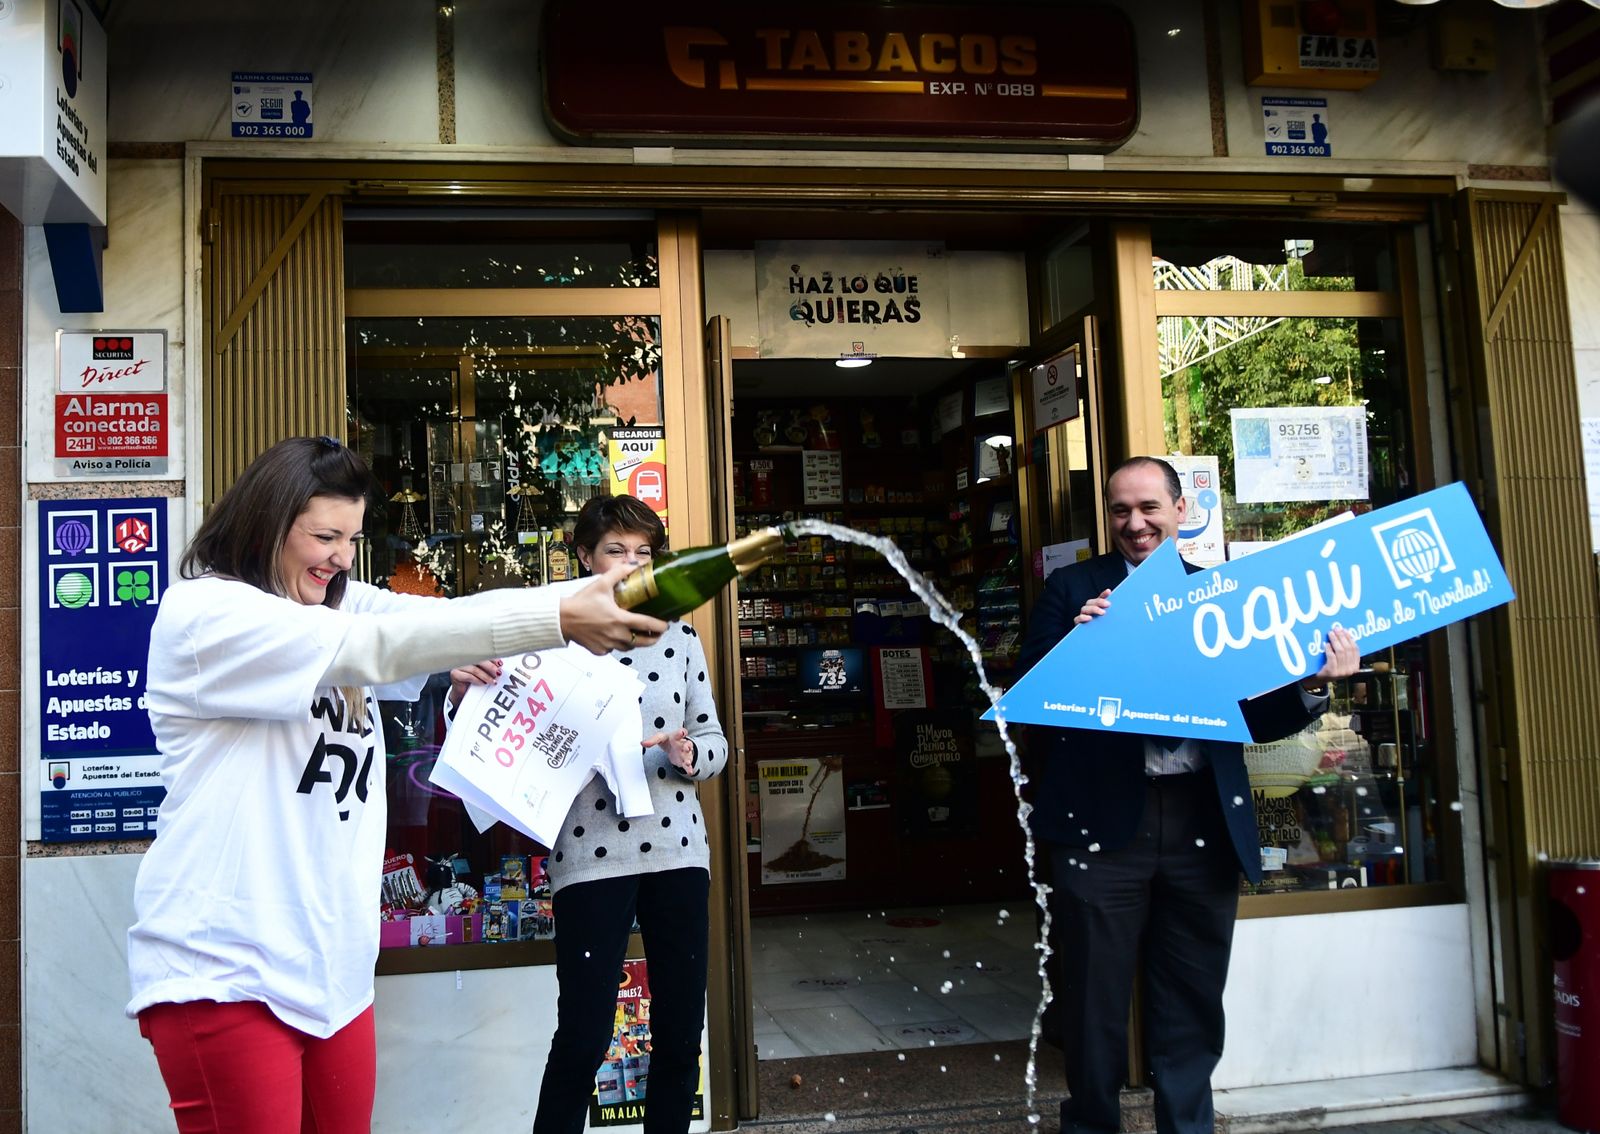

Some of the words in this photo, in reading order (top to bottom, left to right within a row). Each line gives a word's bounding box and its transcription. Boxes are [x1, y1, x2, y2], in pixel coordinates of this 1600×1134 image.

[756, 29, 1038, 76] TABACOS
[1300, 36, 1377, 58] EMSA
[929, 81, 968, 96] EXP.
[997, 83, 1035, 98] 089
[84, 126, 88, 144] y
[240, 125, 258, 135] 902
[262, 126, 281, 136] 365
[285, 127, 305, 136] 000
[57, 113, 86, 162] Apuestas
[88, 151, 97, 175] del
[1271, 144, 1287, 154] 902
[1290, 145, 1306, 155] 365
[1308, 145, 1324, 155] 000
[57, 137, 79, 176] Estado
[789, 275, 834, 294] HAZ
[841, 275, 868, 294] LO
[874, 275, 918, 294] QUE
[789, 297, 921, 325] QUIERAS
[80, 359, 151, 388] Direct
[63, 396, 160, 416] Alarma
[63, 416, 160, 432] conectada
[1278, 423, 1320, 437] 93756
[68, 438, 94, 450] 24H
[107, 435, 122, 445] 902
[124, 435, 140, 445] 366
[141, 435, 157, 445] 366
[621, 440, 654, 452] AQUÍ
[73, 460, 103, 470] Aviso
[1193, 539, 1362, 676] aquí
[1307, 628, 1325, 656] el
[1393, 599, 1416, 625] de
[1414, 568, 1494, 616] Navidad!
[882, 650, 911, 658] BOTES
[46, 667, 122, 686] Loterías
[127, 670, 139, 687] y
[46, 695, 132, 717] Apuestas
[477, 651, 542, 743] PREMIO
[495, 678, 555, 768] 03347
[1089, 706, 1096, 716] y
[1122, 708, 1170, 721] Apuestas
[1172, 713, 1189, 724] del
[1191, 715, 1227, 727] Estado
[47, 721, 111, 741] Estado
[536, 723, 559, 746] MAYOR
[539, 734, 564, 757] PREMIO
[559, 725, 571, 736] ES
[925, 722, 953, 742] MAYOR
[532, 740, 541, 748] EL
[547, 729, 579, 769] COMPARTIRLO
[910, 750, 960, 768] COMPARTIRLO
[135, 770, 160, 778] Estado
[1257, 814, 1282, 829] EMIO
[1260, 828, 1301, 848] ARTIRLO
[637, 985, 643, 997] 2
[617, 1106, 625, 1119] A
[626, 1105, 638, 1119] LA
